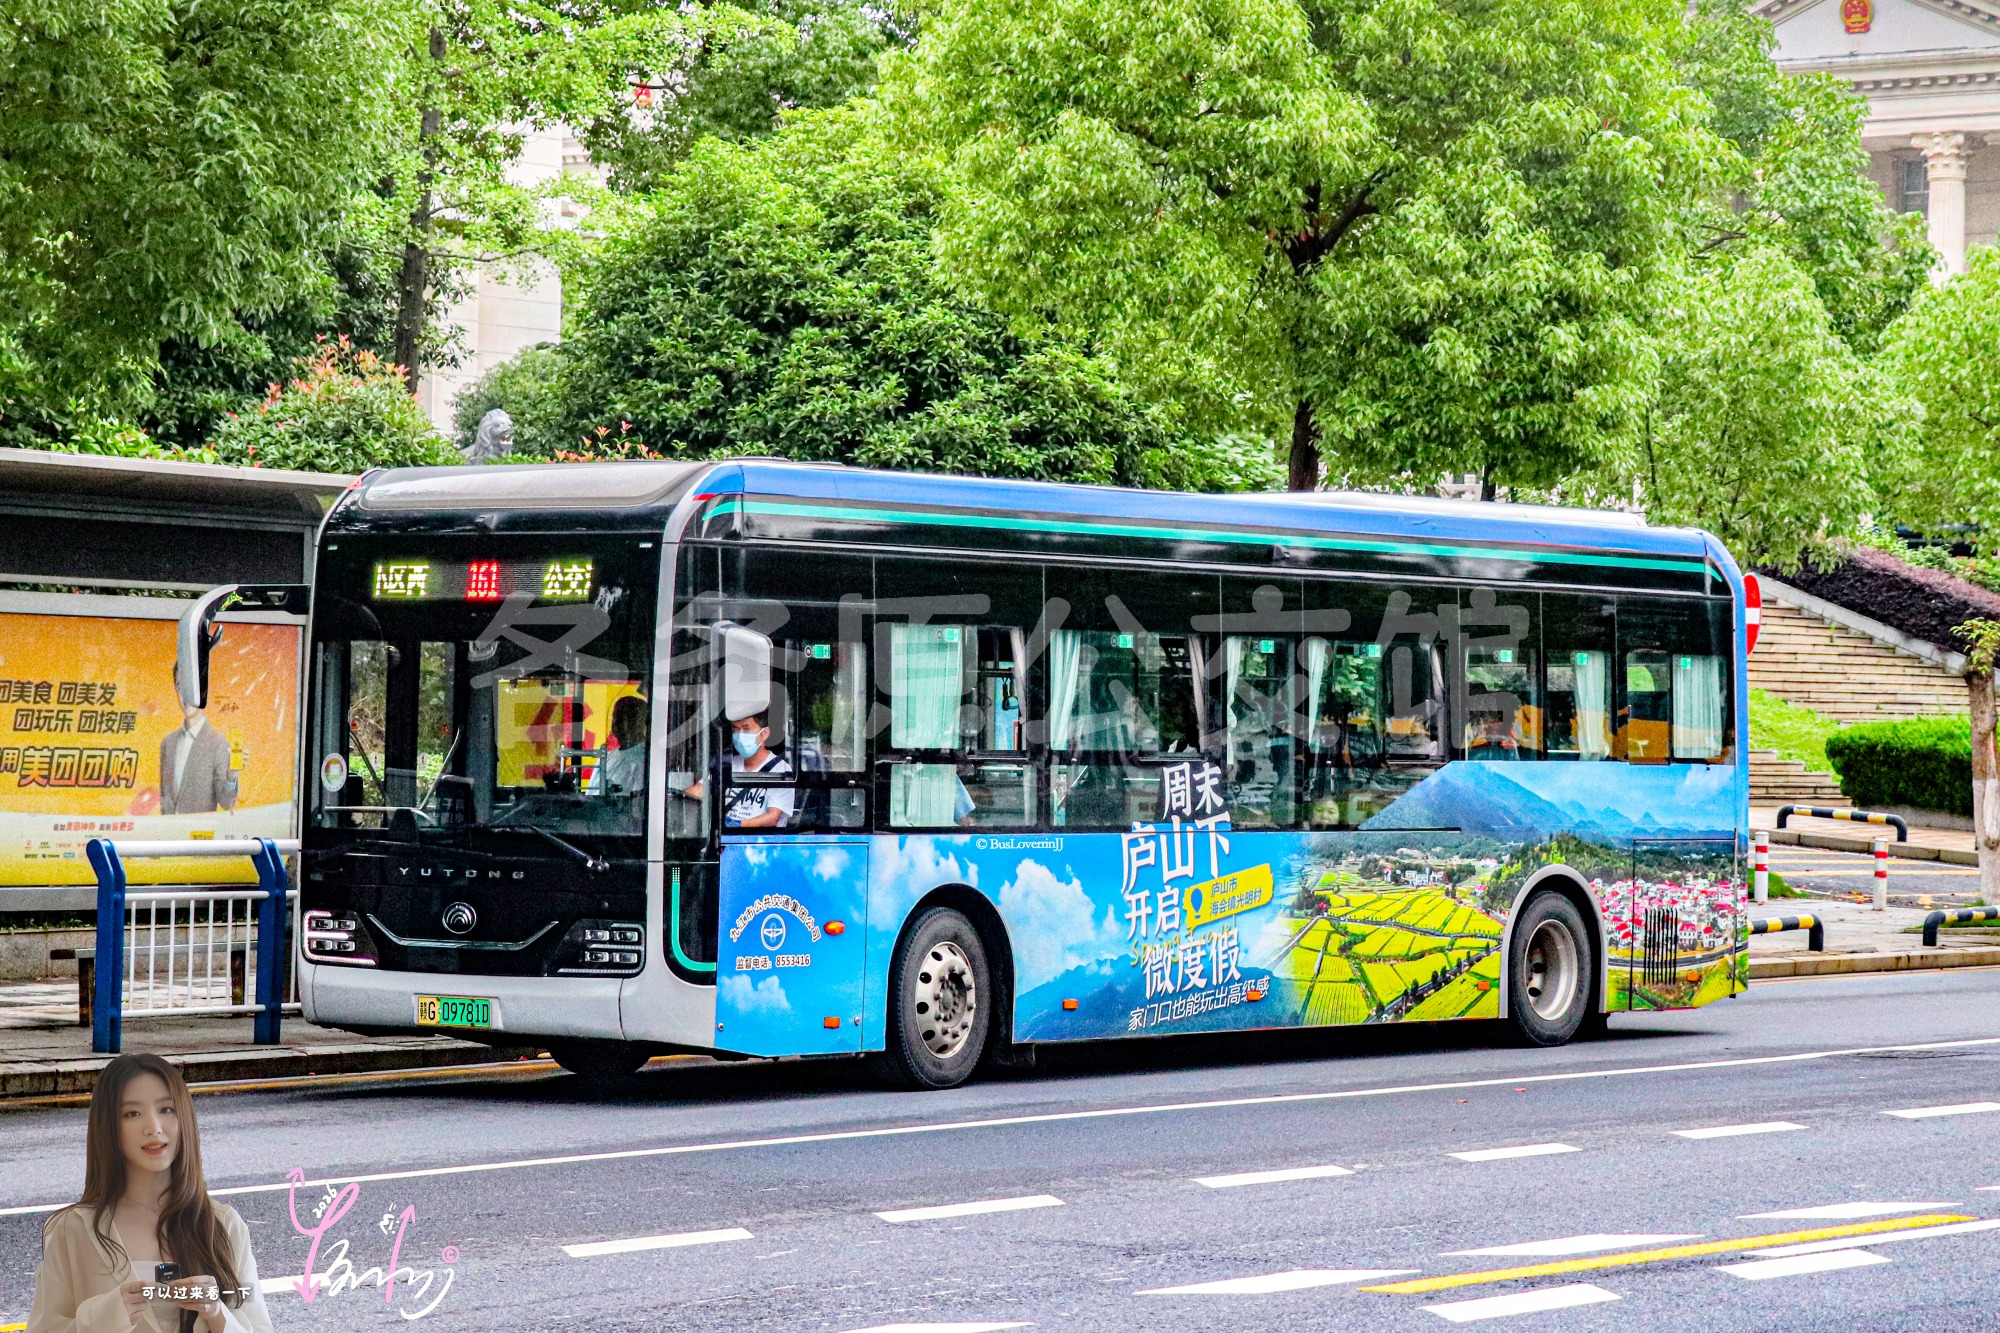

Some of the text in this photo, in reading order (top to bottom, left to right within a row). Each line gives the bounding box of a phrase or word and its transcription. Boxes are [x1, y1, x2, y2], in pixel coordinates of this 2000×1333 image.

[0, 680, 117, 707] 团美食 团美发
[13, 708, 138, 735] 团玩乐 团按摩
[1163, 762, 1224, 819] 周末
[399, 867, 524, 880] YUTONG
[1120, 811, 1231, 895] 庐山下
[1124, 885, 1181, 940] 开启
[1209, 888, 1263, 917] 海会镇光明村
[1210, 877, 1238, 898] 庐山市
[729, 893, 822, 943] 九江市公共交通集团公司
[1142, 928, 1241, 1000] 微度假
[1127, 975, 1271, 1032] 家门口也能玩出高级感
